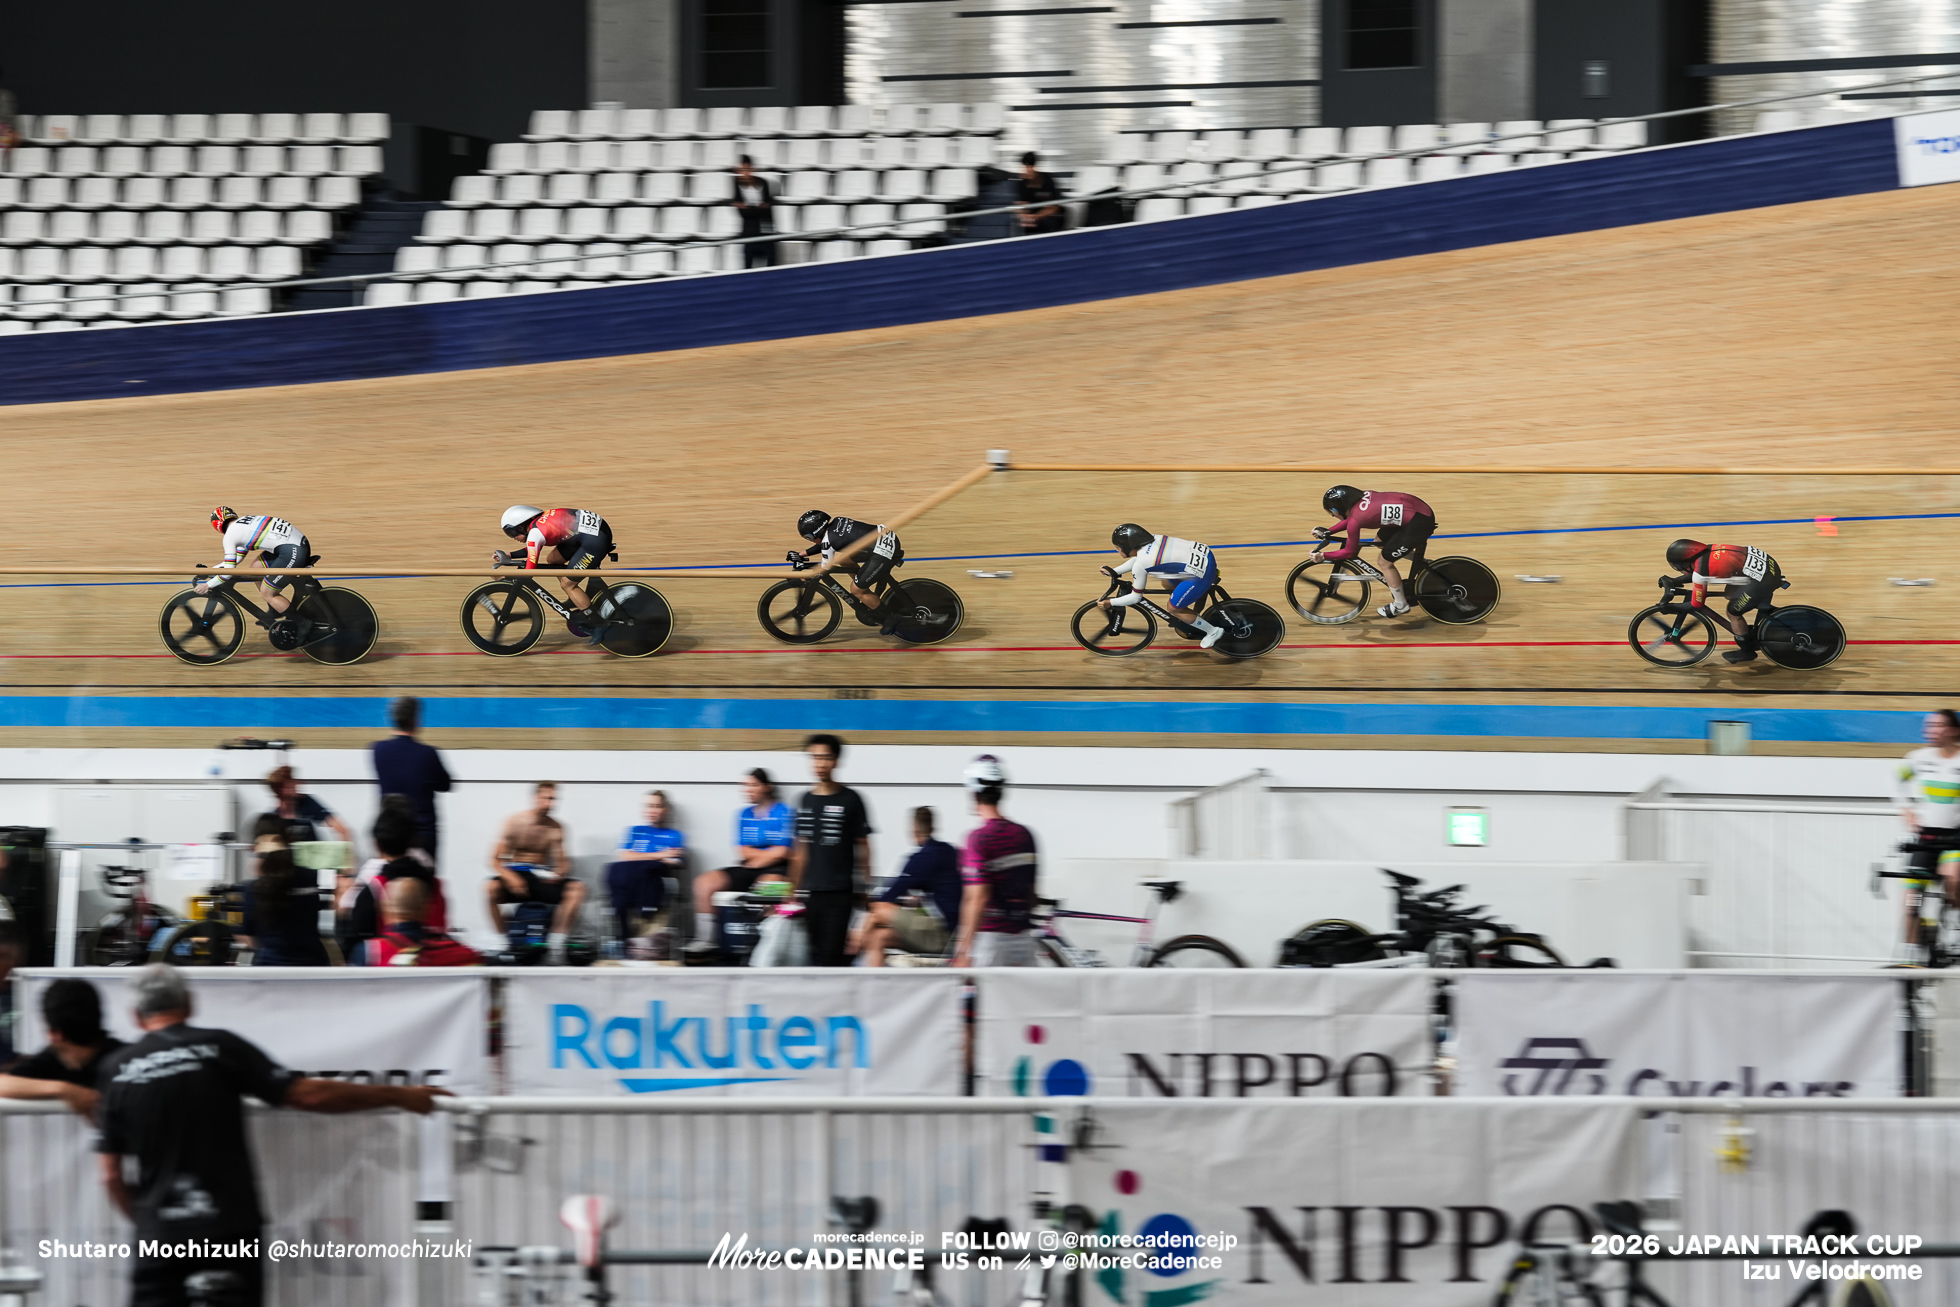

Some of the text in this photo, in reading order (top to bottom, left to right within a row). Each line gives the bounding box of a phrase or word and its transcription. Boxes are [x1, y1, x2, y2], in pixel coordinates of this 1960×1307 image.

[581, 514, 598, 528] 132
[1383, 506, 1401, 520] 138
[271, 521, 288, 534] 141
[878, 535, 894, 551] 144
[1189, 553, 1205, 570] 131
[1747, 556, 1764, 572] 133
[535, 588, 571, 620] KOGA
[549, 1000, 870, 1070] Rakuten
[1122, 1052, 1400, 1097] NIPPO
